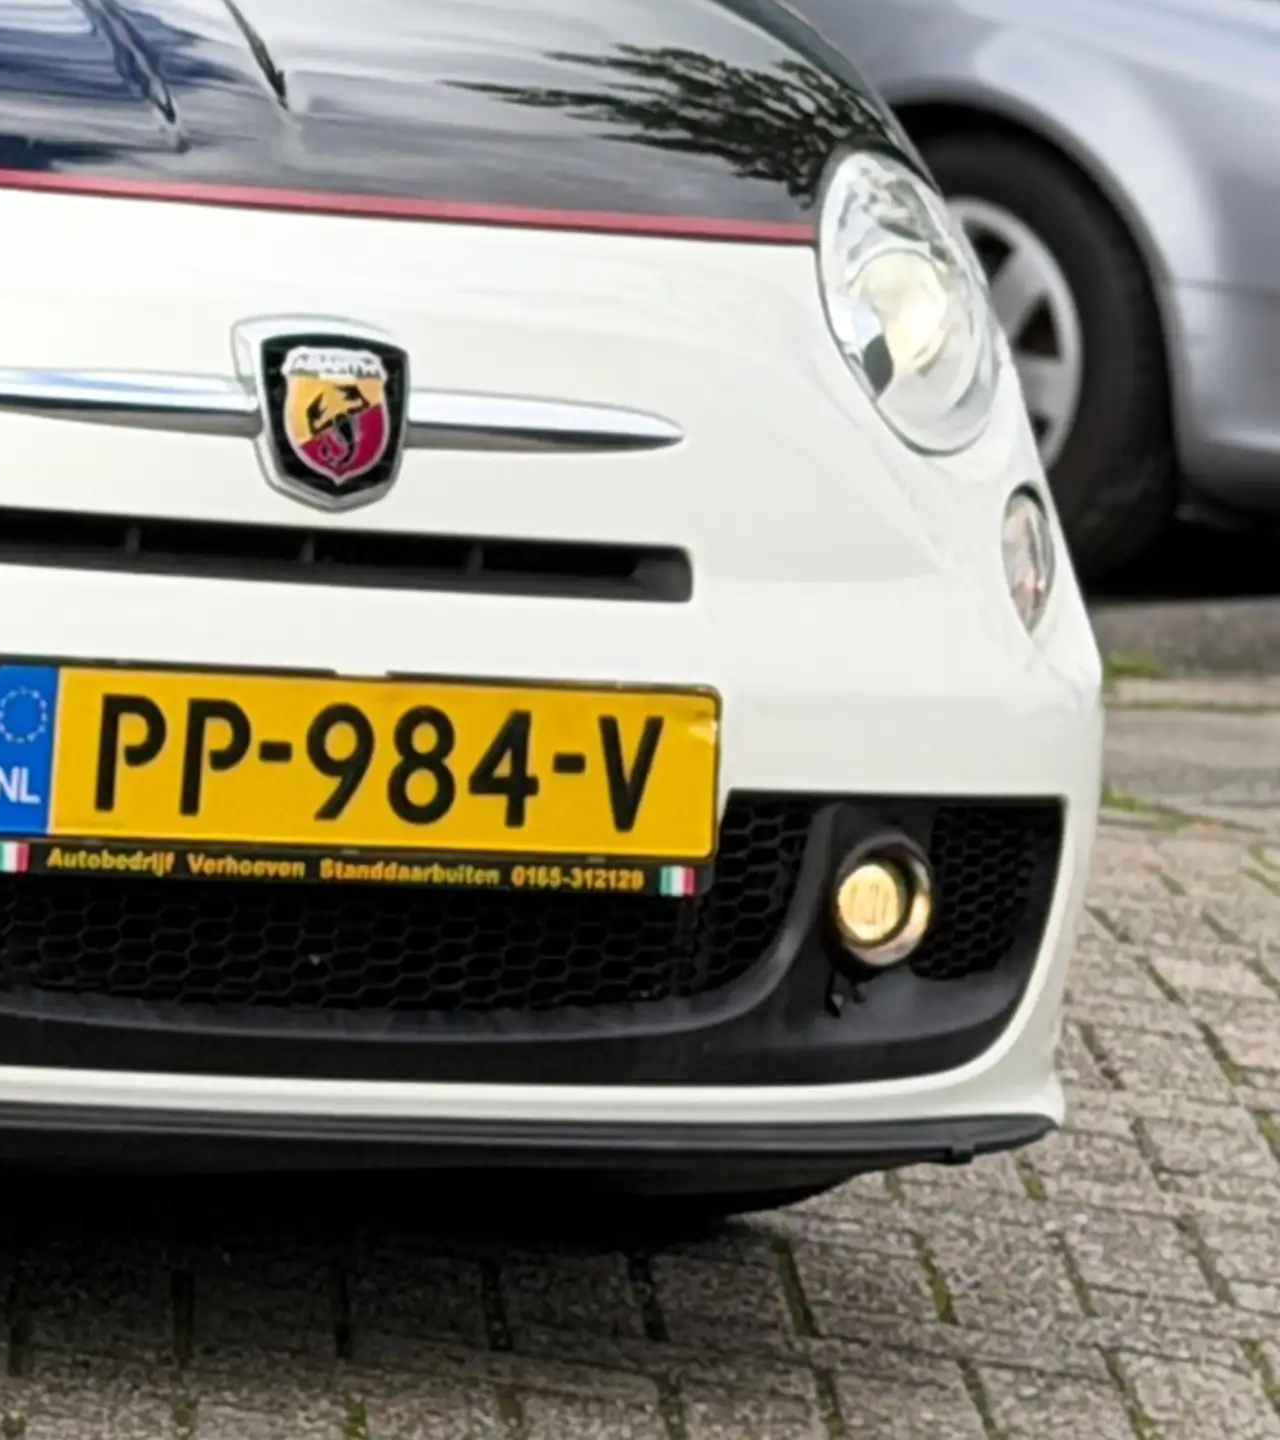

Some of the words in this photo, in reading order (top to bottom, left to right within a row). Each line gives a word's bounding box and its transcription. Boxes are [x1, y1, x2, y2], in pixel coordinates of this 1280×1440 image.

[94, 692, 665, 833] PP-984-V
[46, 846, 175, 878] Autobedrijf
[186, 852, 306, 880] Verhoeven
